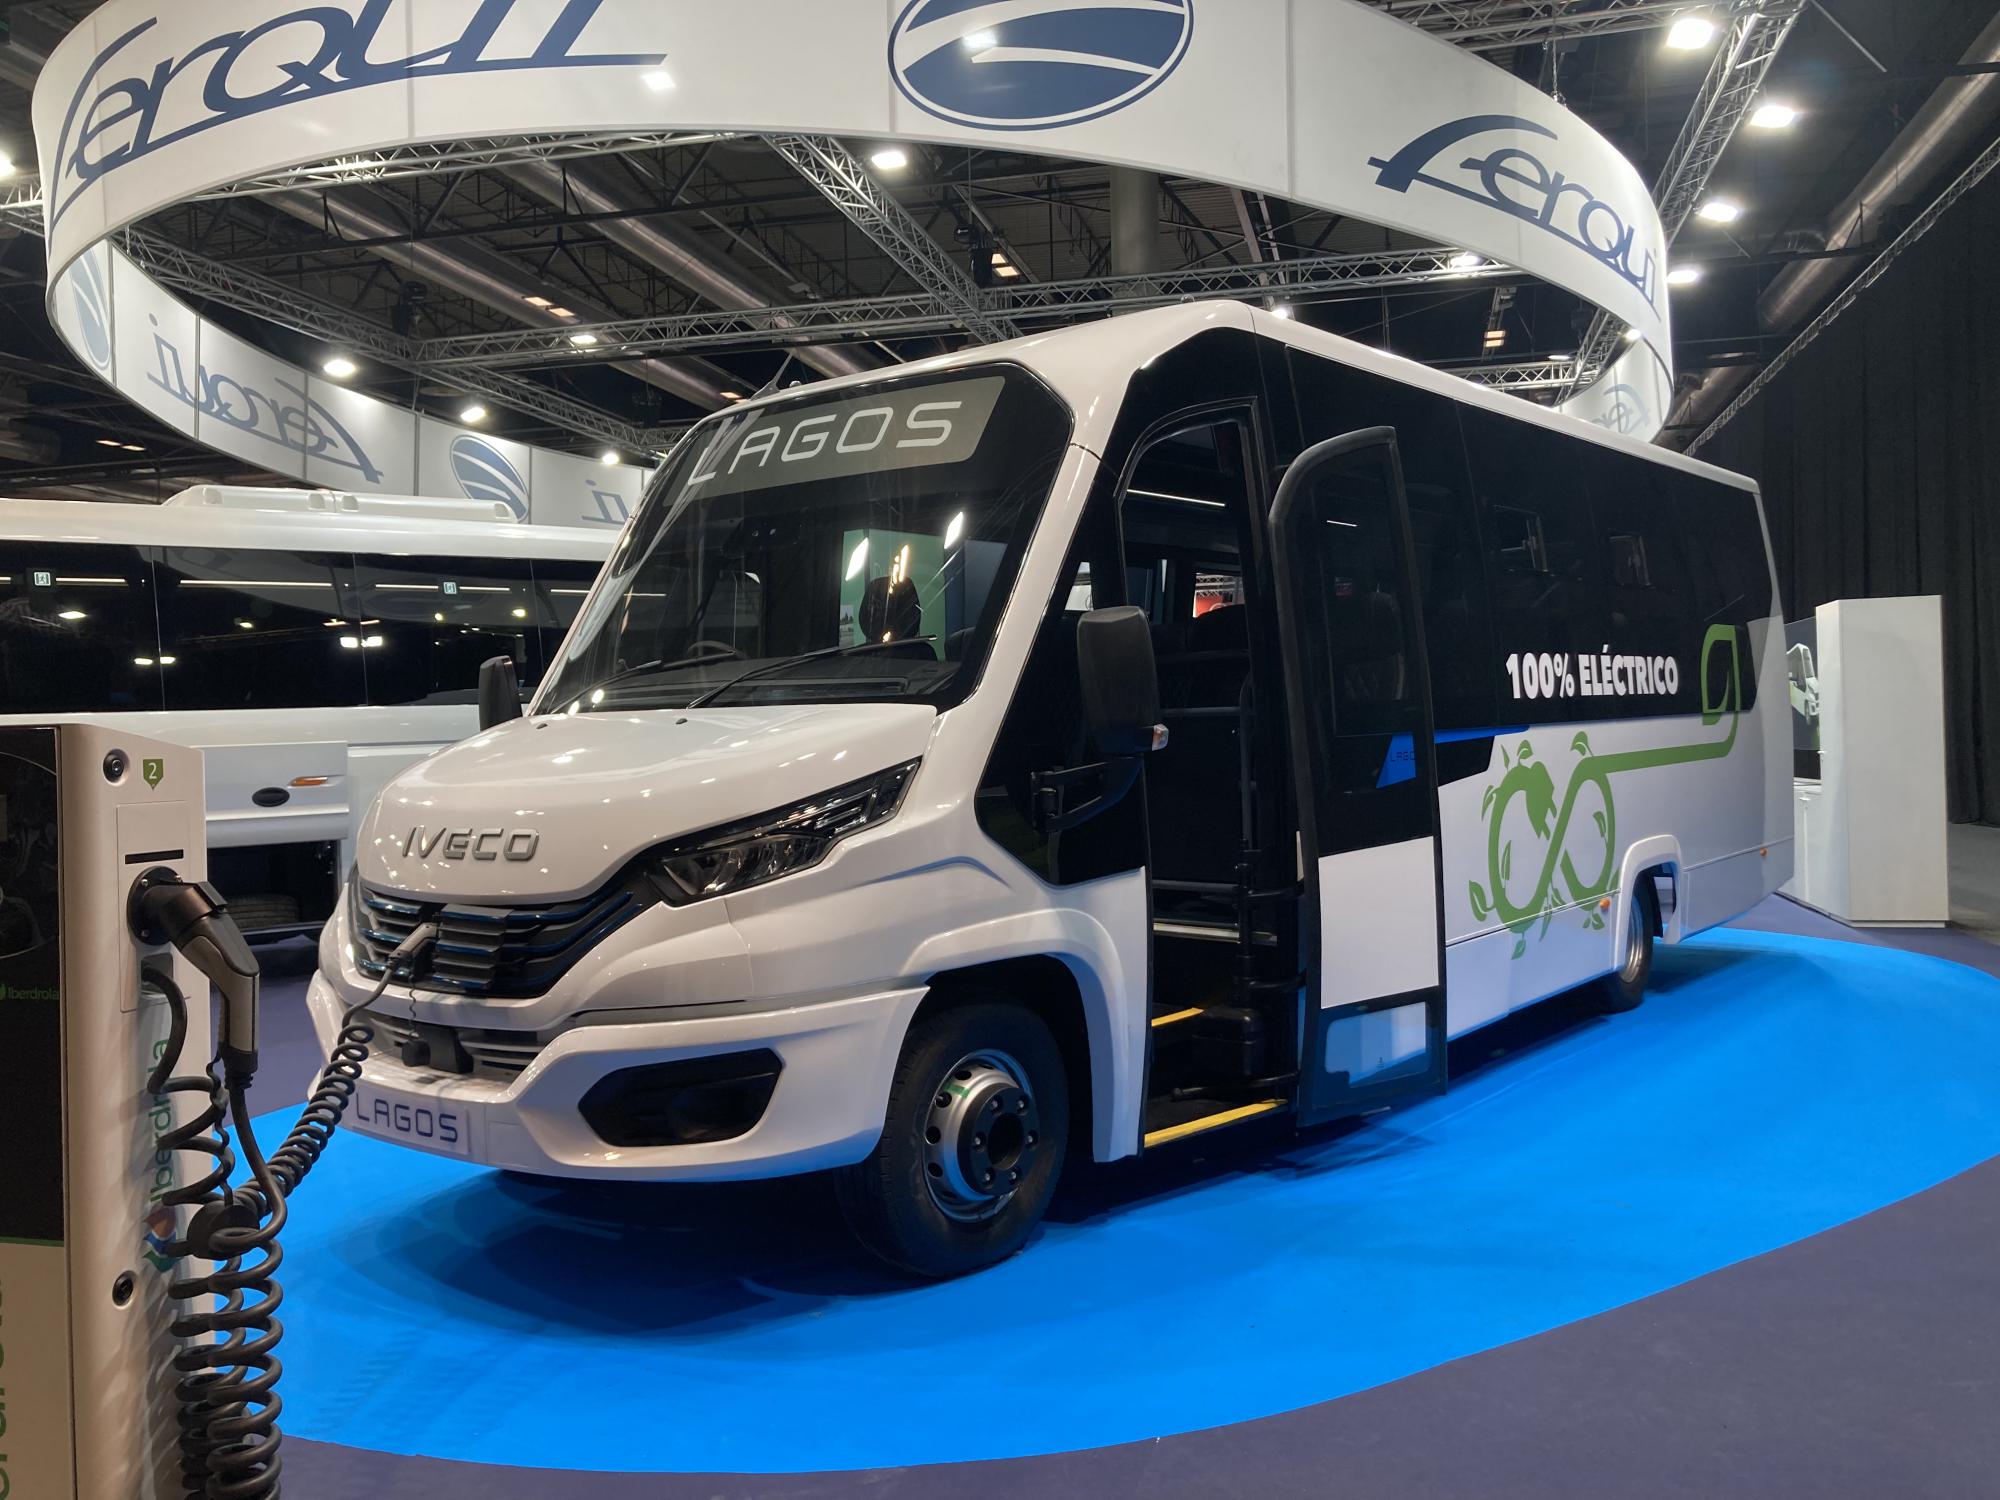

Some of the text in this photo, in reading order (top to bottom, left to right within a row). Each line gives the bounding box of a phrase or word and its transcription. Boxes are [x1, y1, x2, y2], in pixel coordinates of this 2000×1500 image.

[687, 401, 962, 486] LAGOS
[1506, 644, 1678, 699] 100% ELÉCTRICO
[148, 762, 157, 779] 2
[402, 825, 540, 861] IVECO
[356, 1093, 459, 1144] LAGOS
